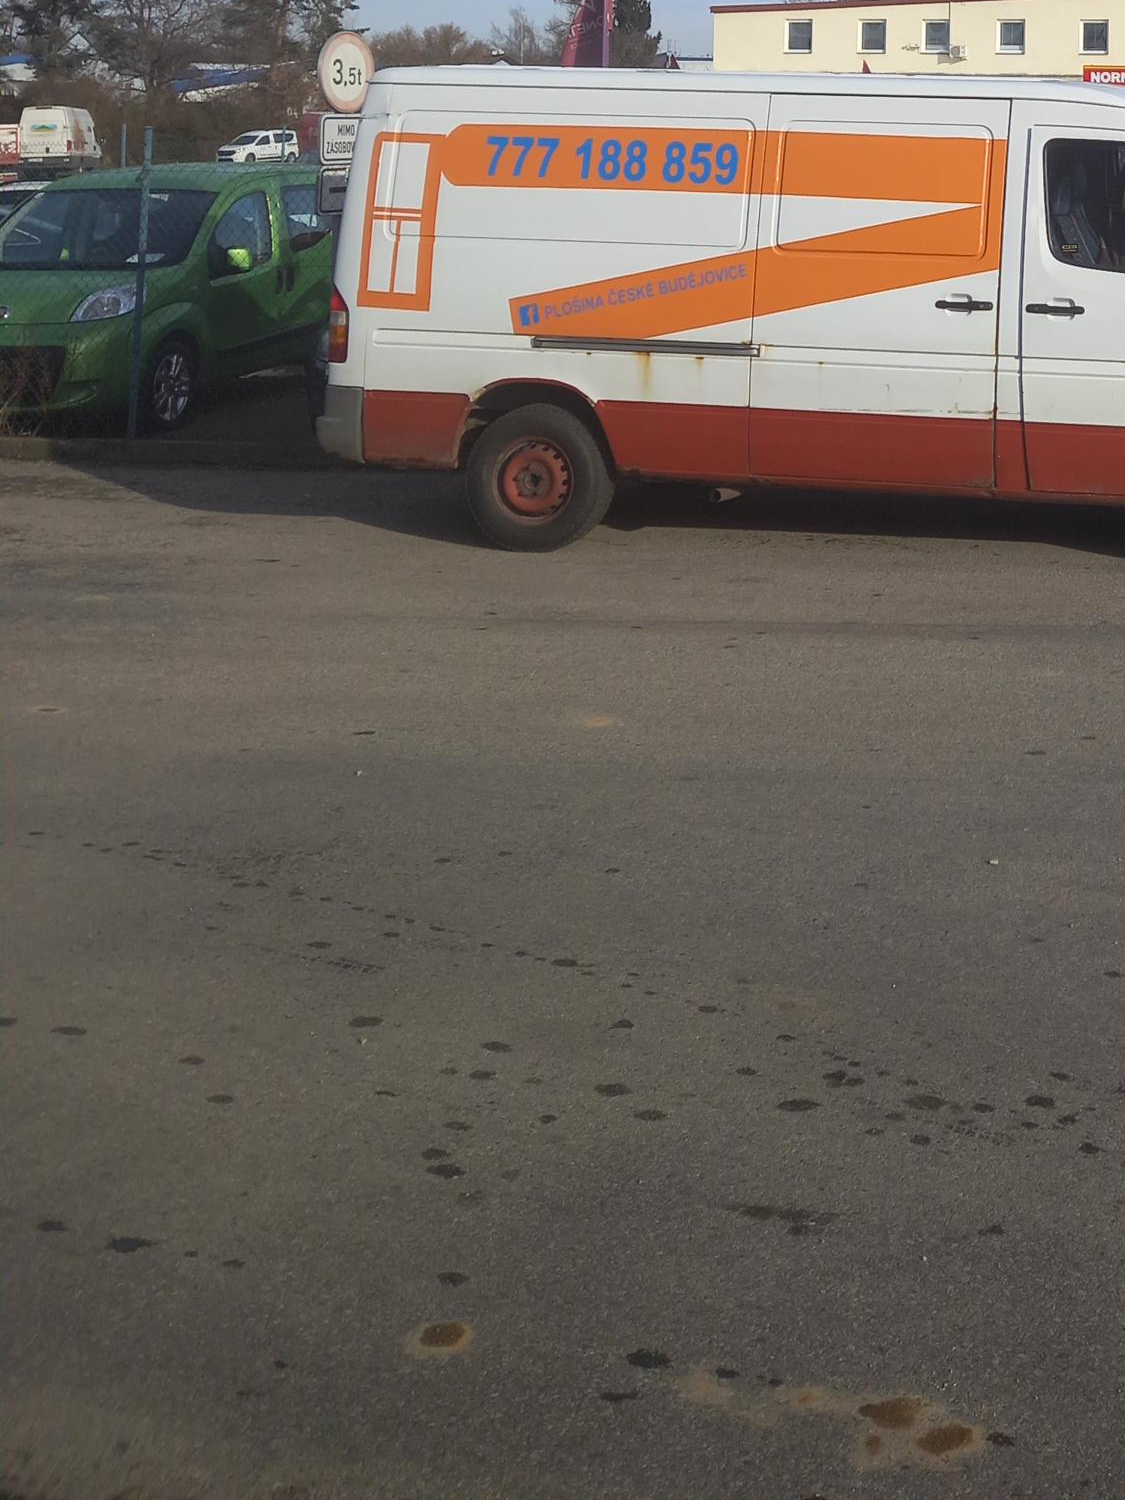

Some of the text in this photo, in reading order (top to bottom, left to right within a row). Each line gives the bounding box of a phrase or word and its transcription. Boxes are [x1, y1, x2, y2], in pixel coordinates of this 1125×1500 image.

[338, 124, 355, 137] MIMO
[486, 136, 739, 185] 777 188 859
[544, 296, 604, 319] PLOŠINA
[607, 283, 655, 306] ČESKÉ
[658, 263, 748, 295] BUDĚJOVICE
